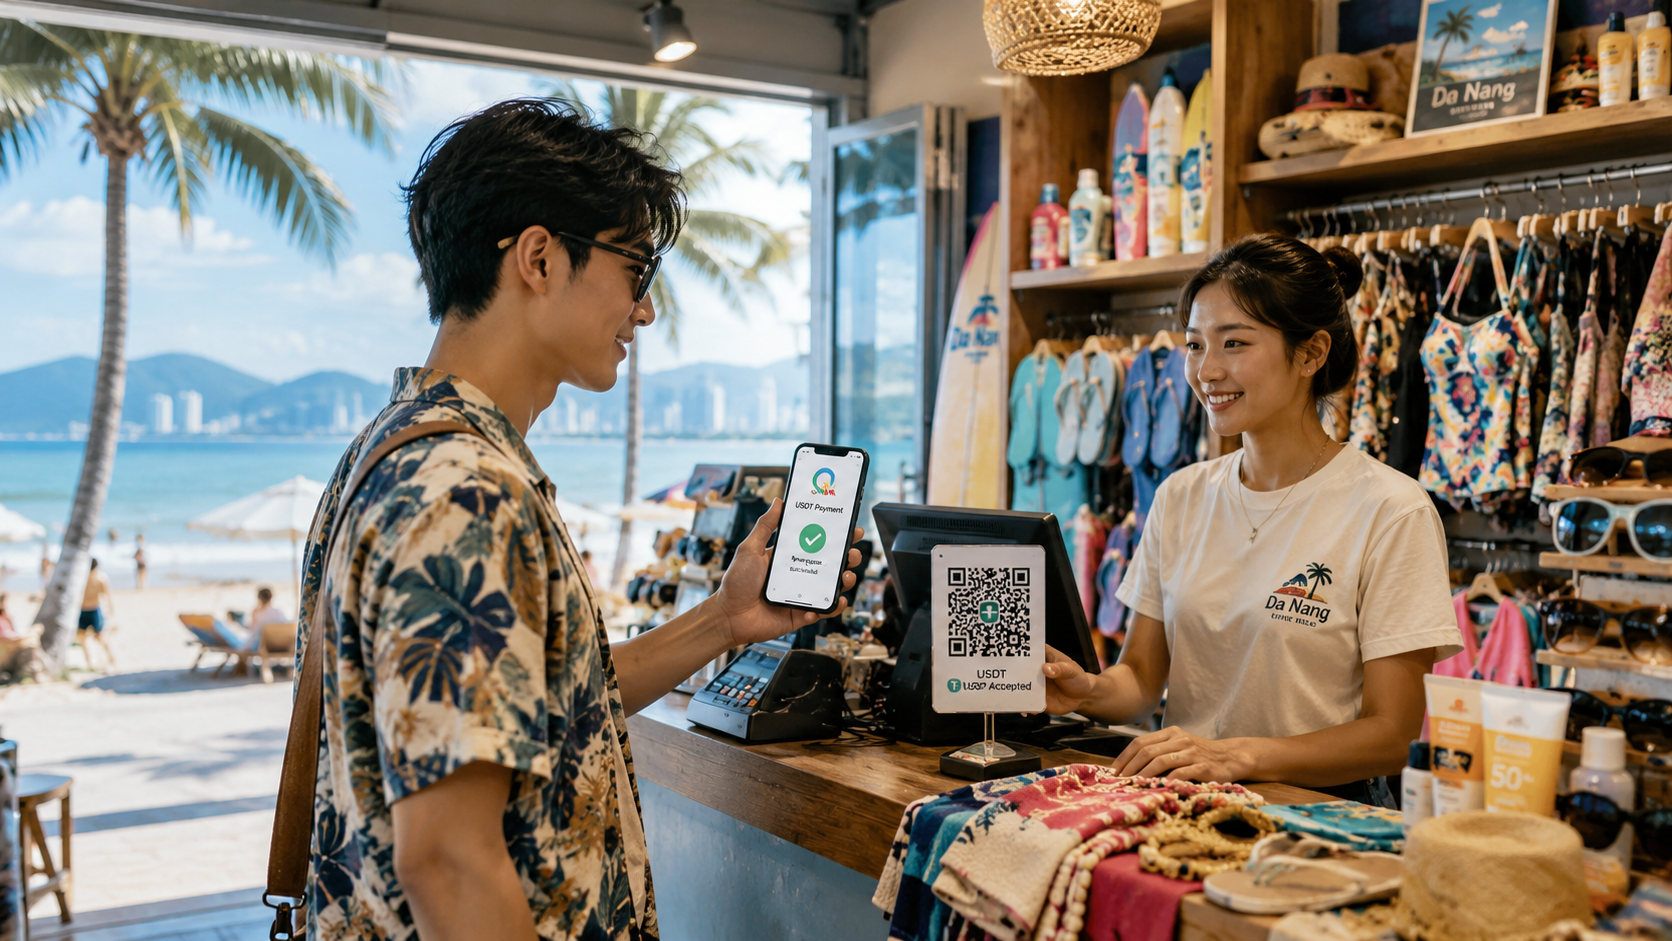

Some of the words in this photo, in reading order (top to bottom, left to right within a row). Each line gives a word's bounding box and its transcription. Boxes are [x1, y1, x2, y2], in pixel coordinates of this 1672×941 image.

[1431, 86, 1458, 108] Da
[1464, 81, 1516, 102] Nang
[795, 501, 814, 510] USDT
[1265, 595, 1286, 611] Da
[1288, 597, 1331, 623] Nang
[977, 669, 1007, 679] USDT
[989, 682, 1032, 692] Accepted
